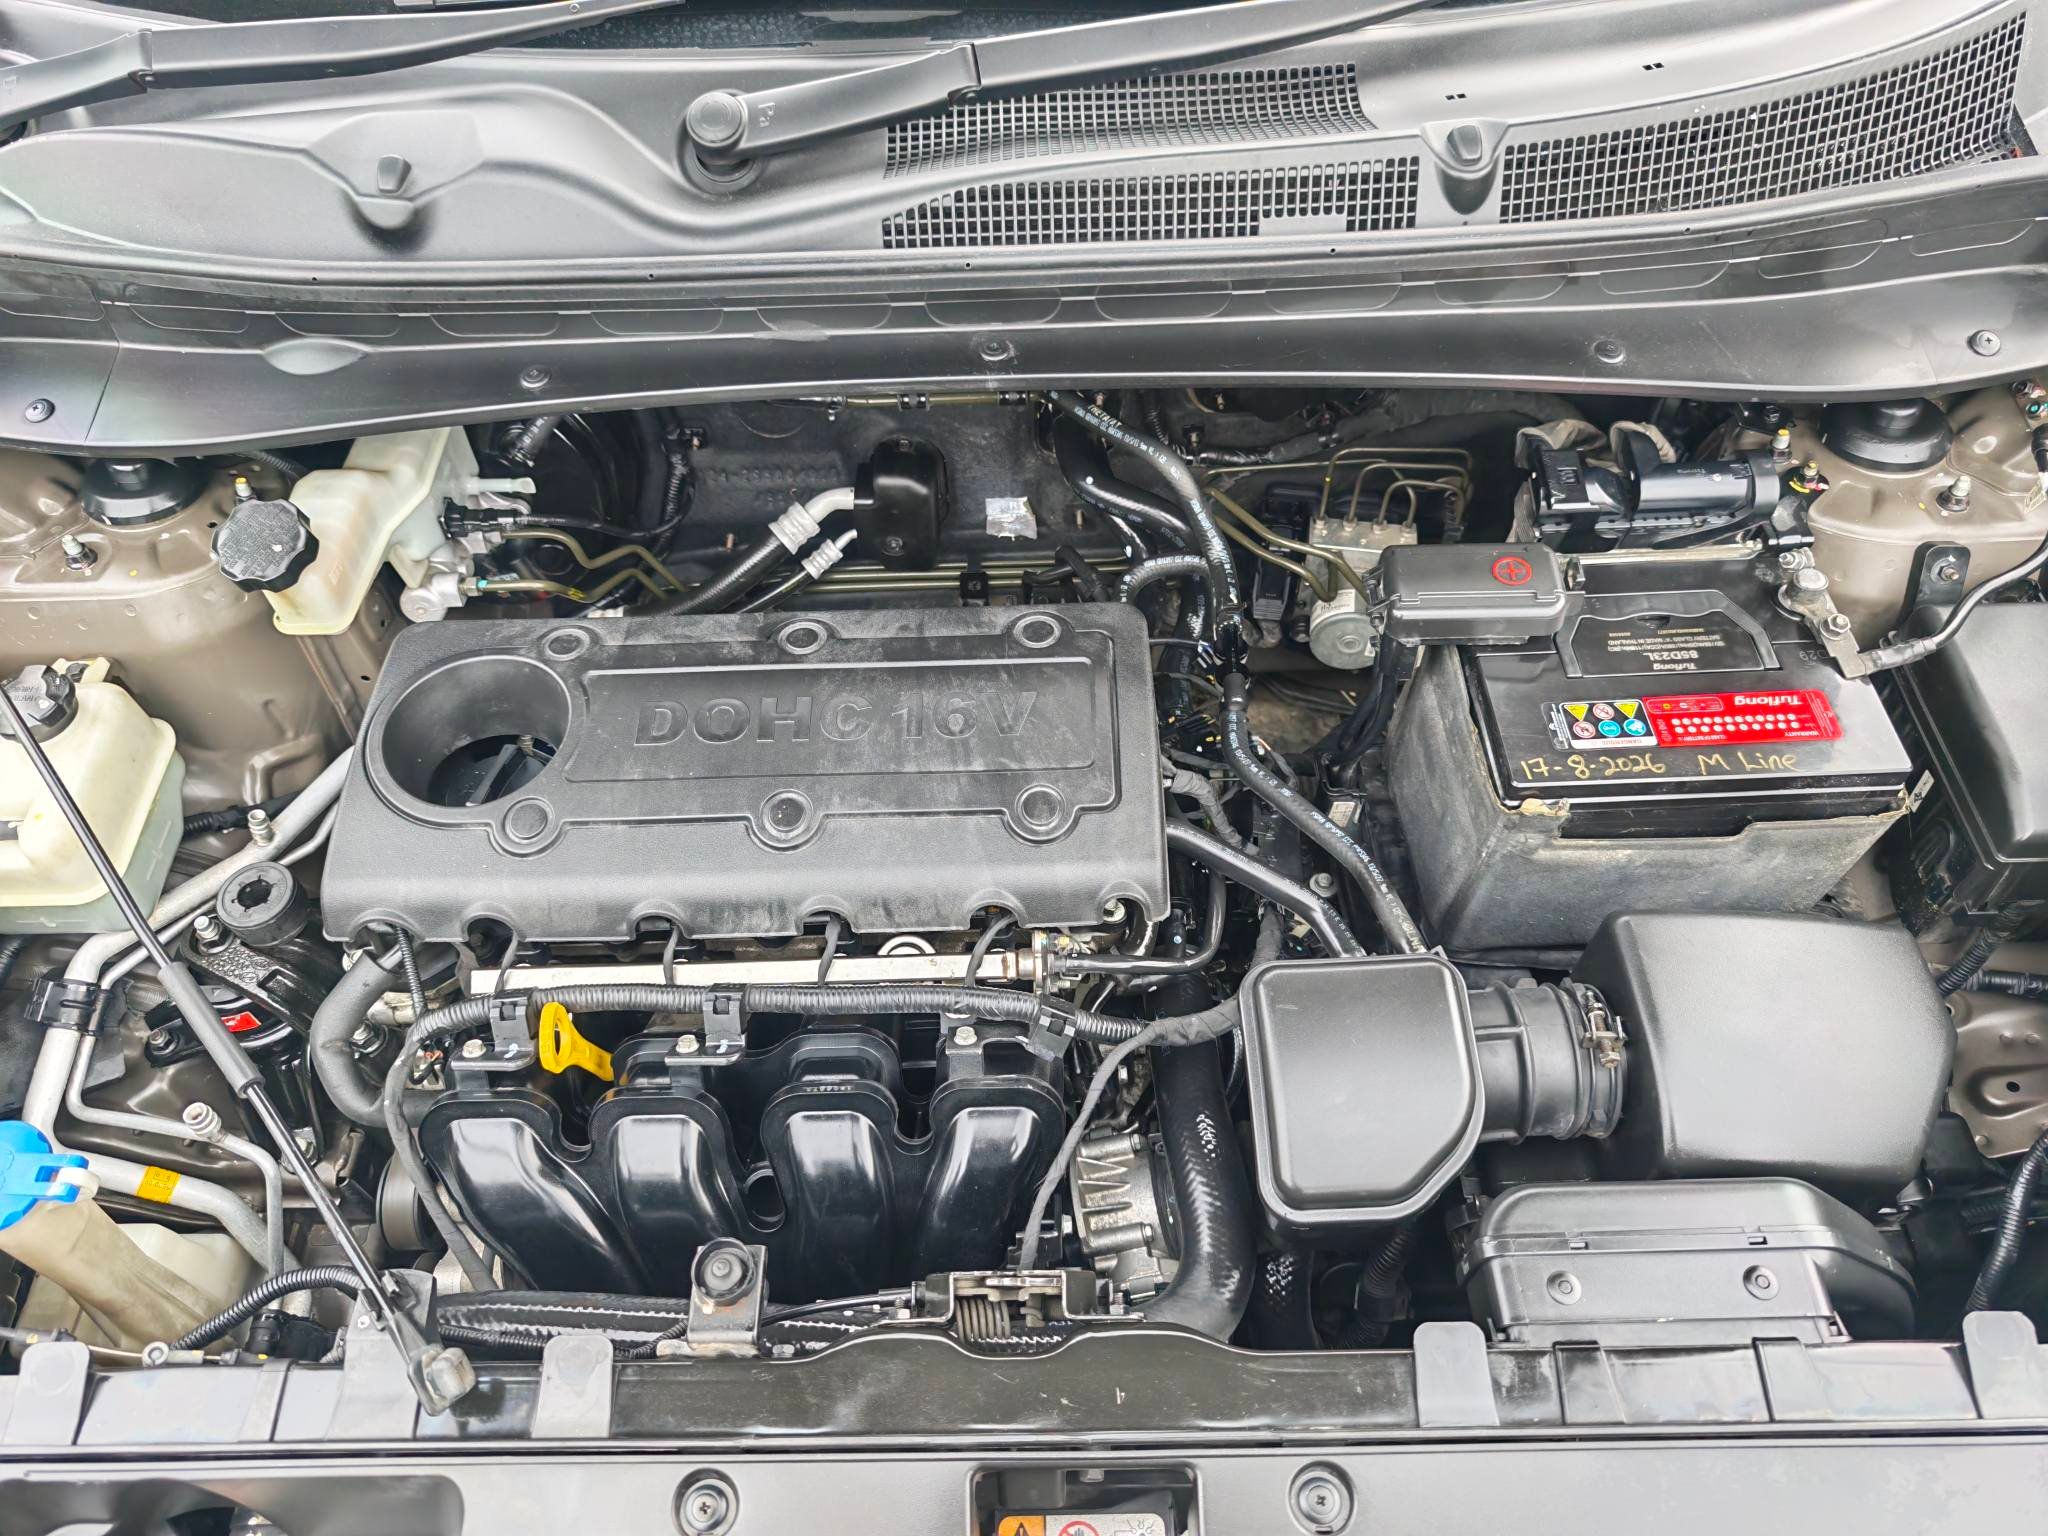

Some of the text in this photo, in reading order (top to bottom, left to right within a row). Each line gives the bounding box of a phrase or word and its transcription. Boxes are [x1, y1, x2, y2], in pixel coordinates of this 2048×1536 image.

[1642, 650, 1698, 661] 85D23L
[1734, 695, 1802, 707] Tuflong
[634, 691, 1037, 746] DOHC 16V
[1520, 752, 1802, 780] 17-8-2026 M Line
